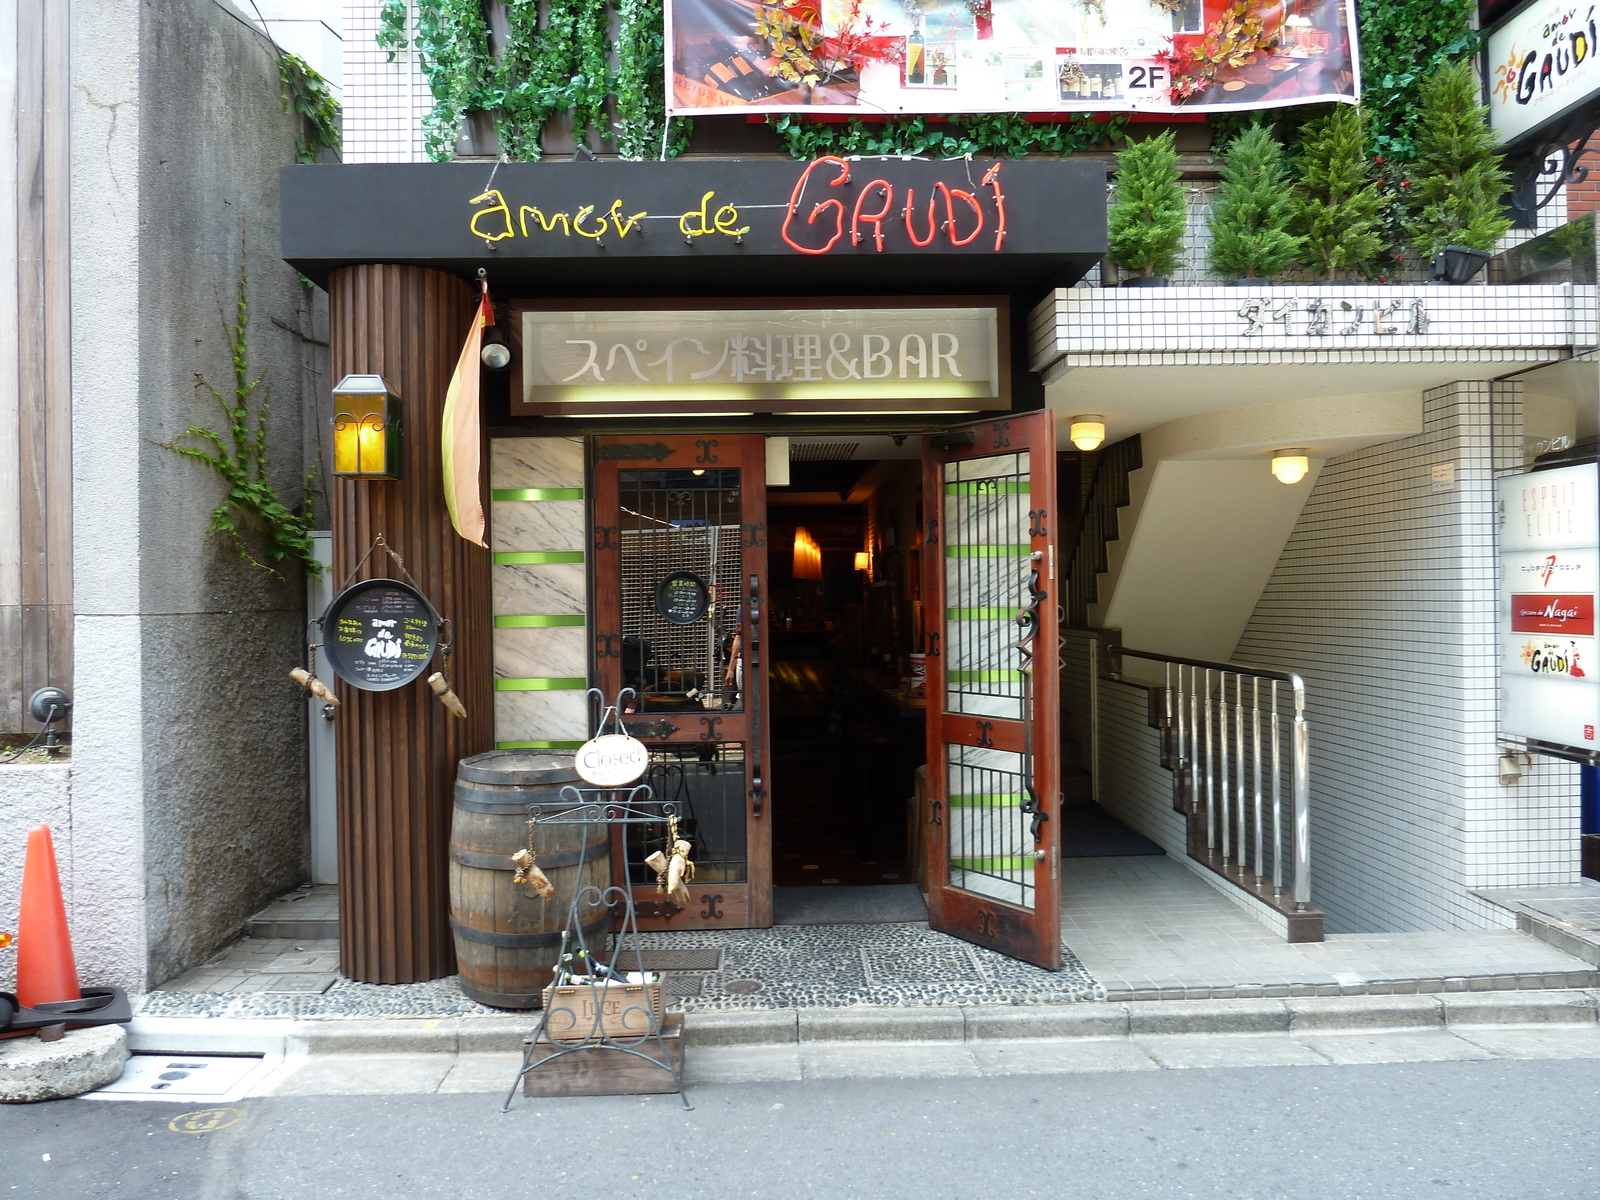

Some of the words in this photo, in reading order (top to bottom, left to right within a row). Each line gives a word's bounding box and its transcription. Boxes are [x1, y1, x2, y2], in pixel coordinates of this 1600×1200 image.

[1129, 66, 1164, 89] 2F
[679, 190, 750, 237] de
[1238, 296, 1432, 336] ダイカンビル
[562, 331, 963, 383] スペイン料理&BAR
[1543, 598, 1579, 622] Nagai
[377, 628, 395, 639] de
[584, 746, 641, 768] Closed
